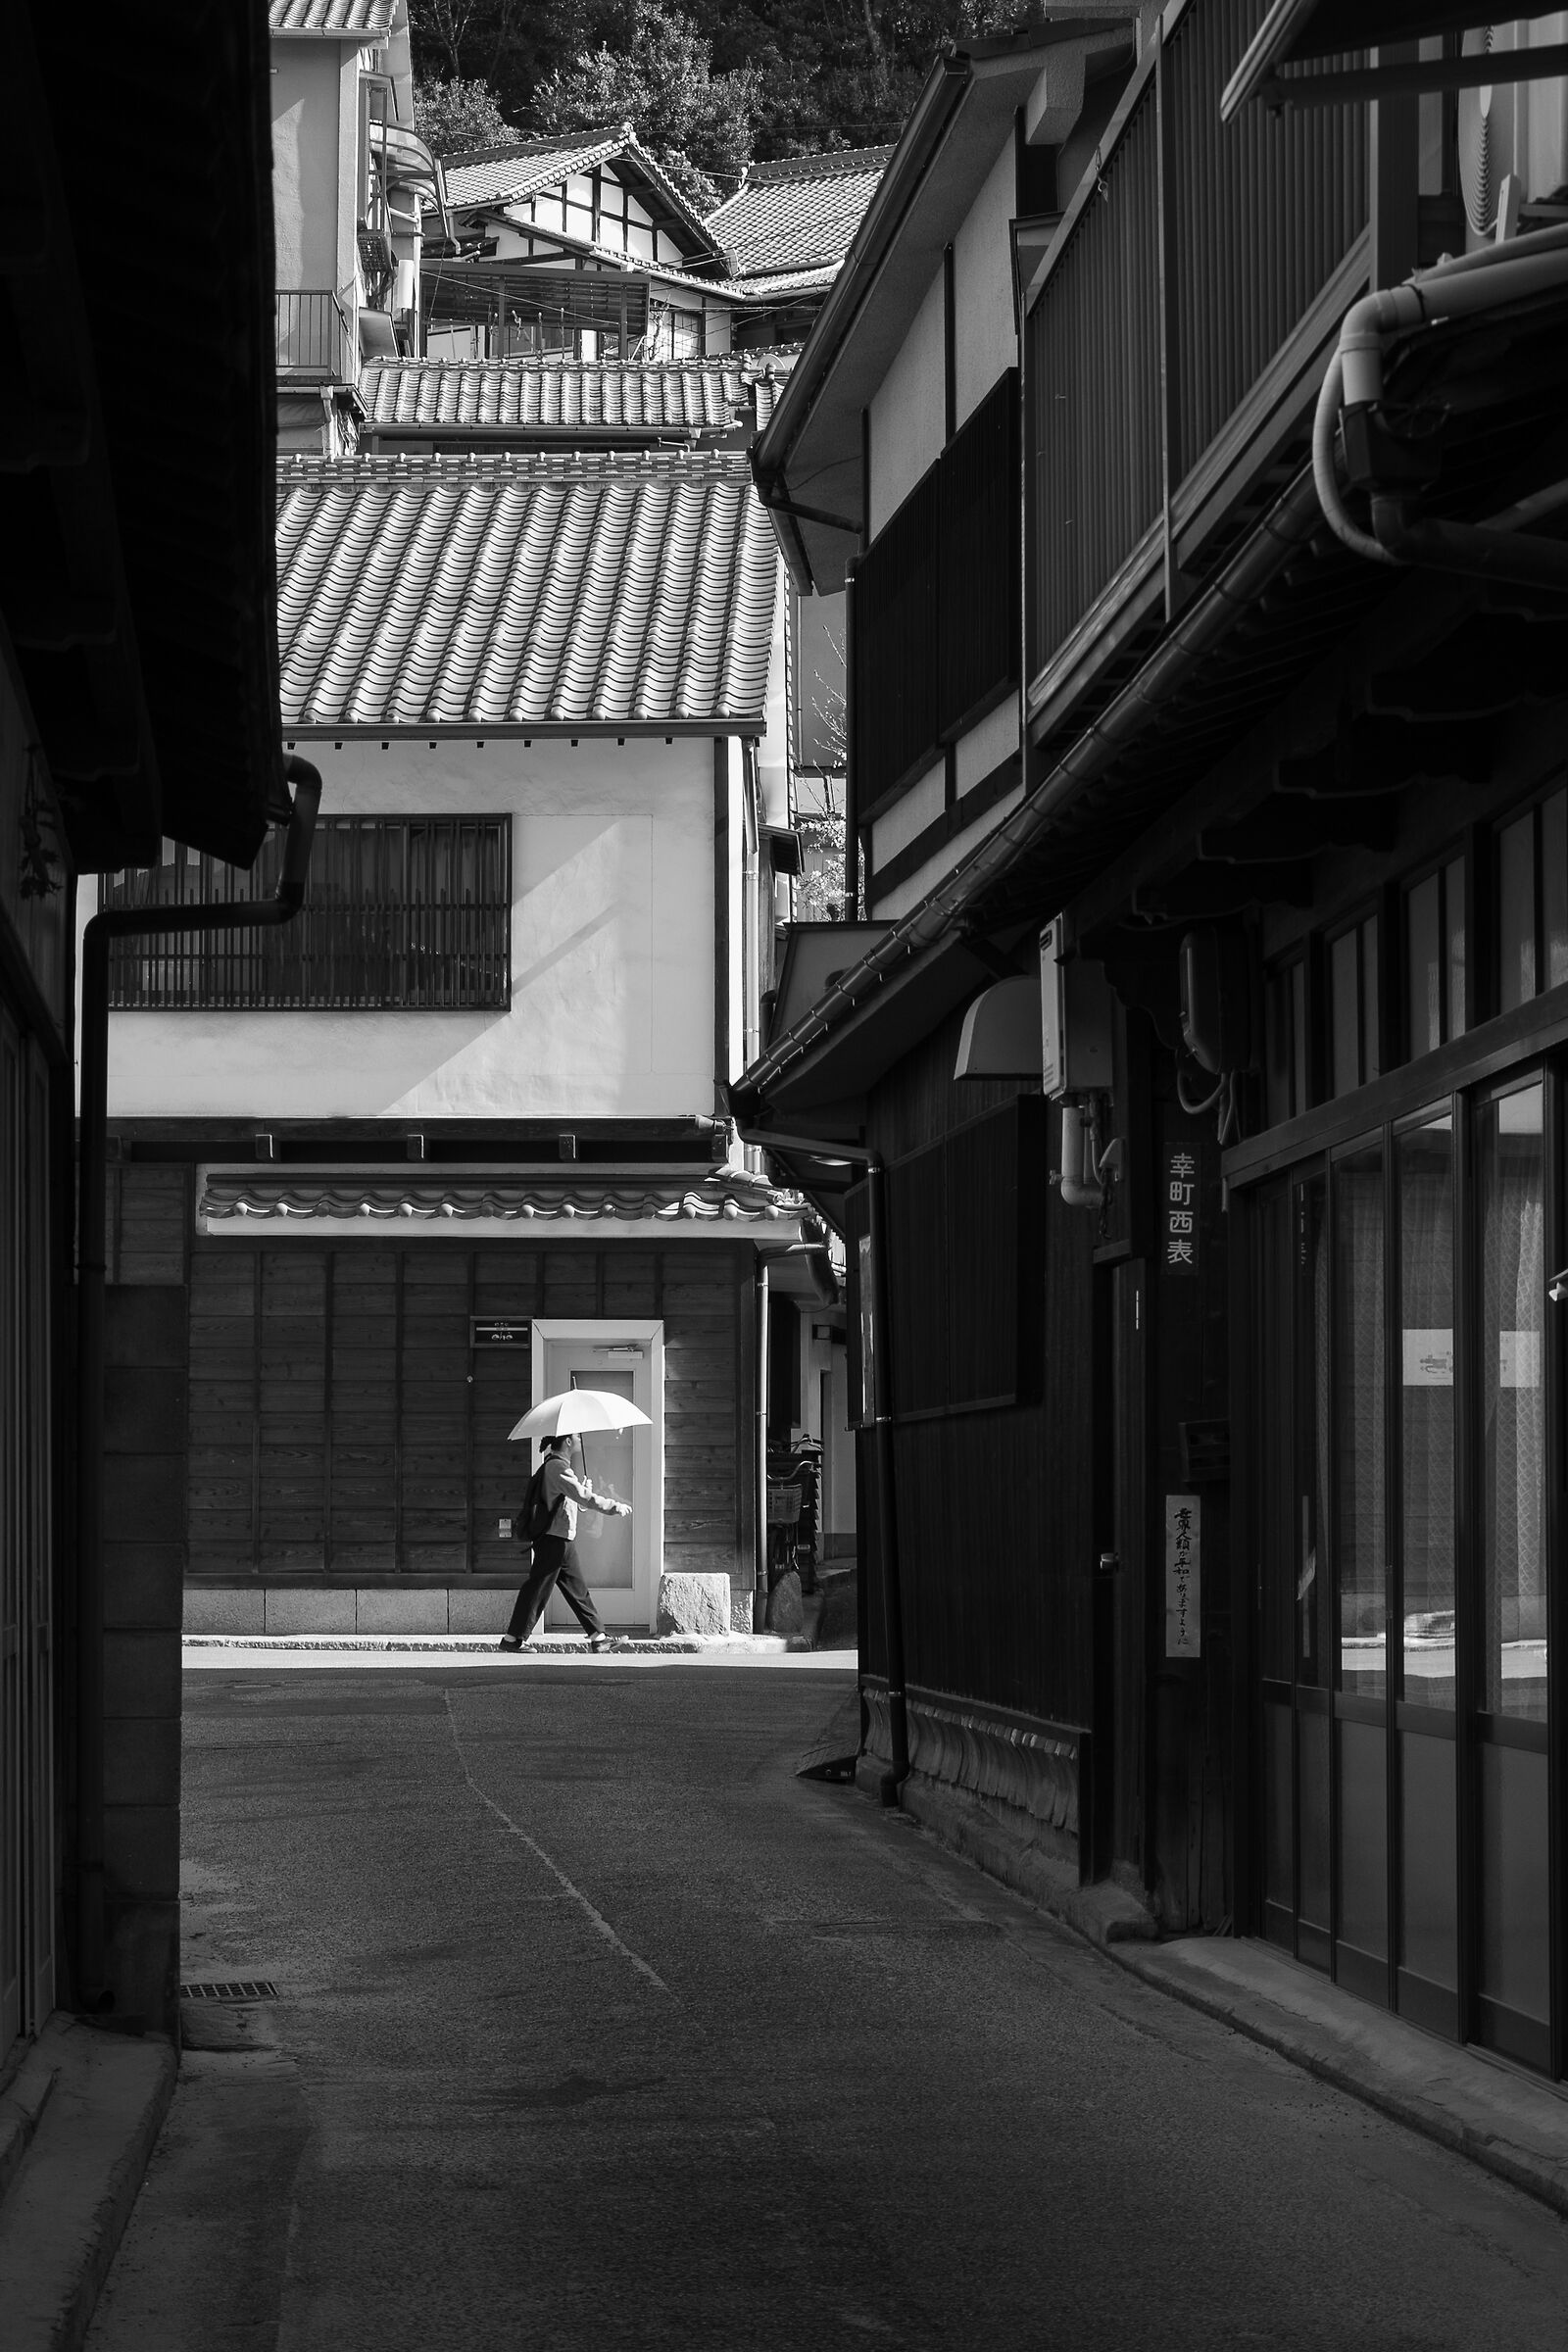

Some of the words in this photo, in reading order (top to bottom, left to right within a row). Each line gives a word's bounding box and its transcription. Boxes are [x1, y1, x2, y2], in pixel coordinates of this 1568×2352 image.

[1166, 1152, 1195, 1264] 幸町西表
[1173, 1507, 1192, 1645] 世界人類が平和でありますように
